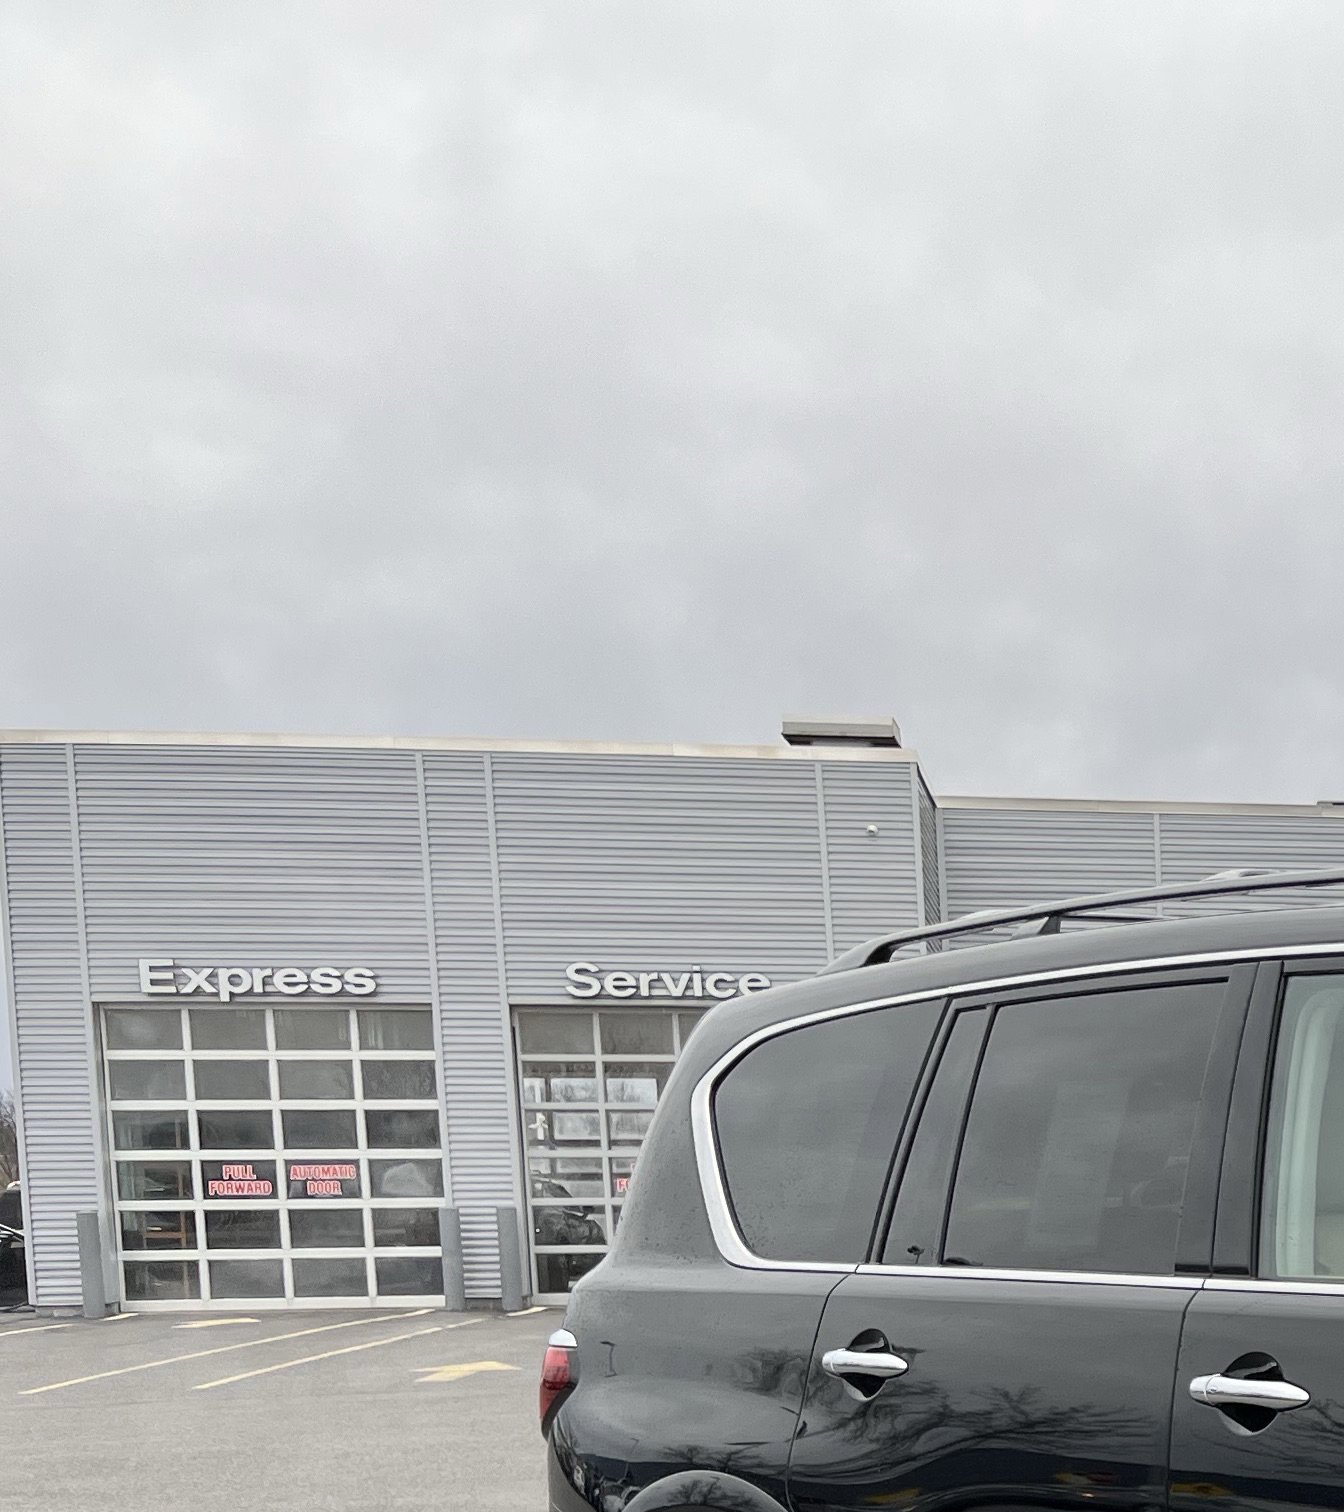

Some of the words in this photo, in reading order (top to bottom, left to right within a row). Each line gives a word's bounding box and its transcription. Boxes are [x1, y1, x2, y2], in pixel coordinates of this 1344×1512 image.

[138, 958, 378, 1003] Express
[565, 961, 772, 999] Service
[223, 1164, 257, 1180] PULL
[289, 1164, 357, 1180] AUTOMATIC
[208, 1180, 273, 1196] FORWARD
[306, 1180, 342, 1196] DOOR
